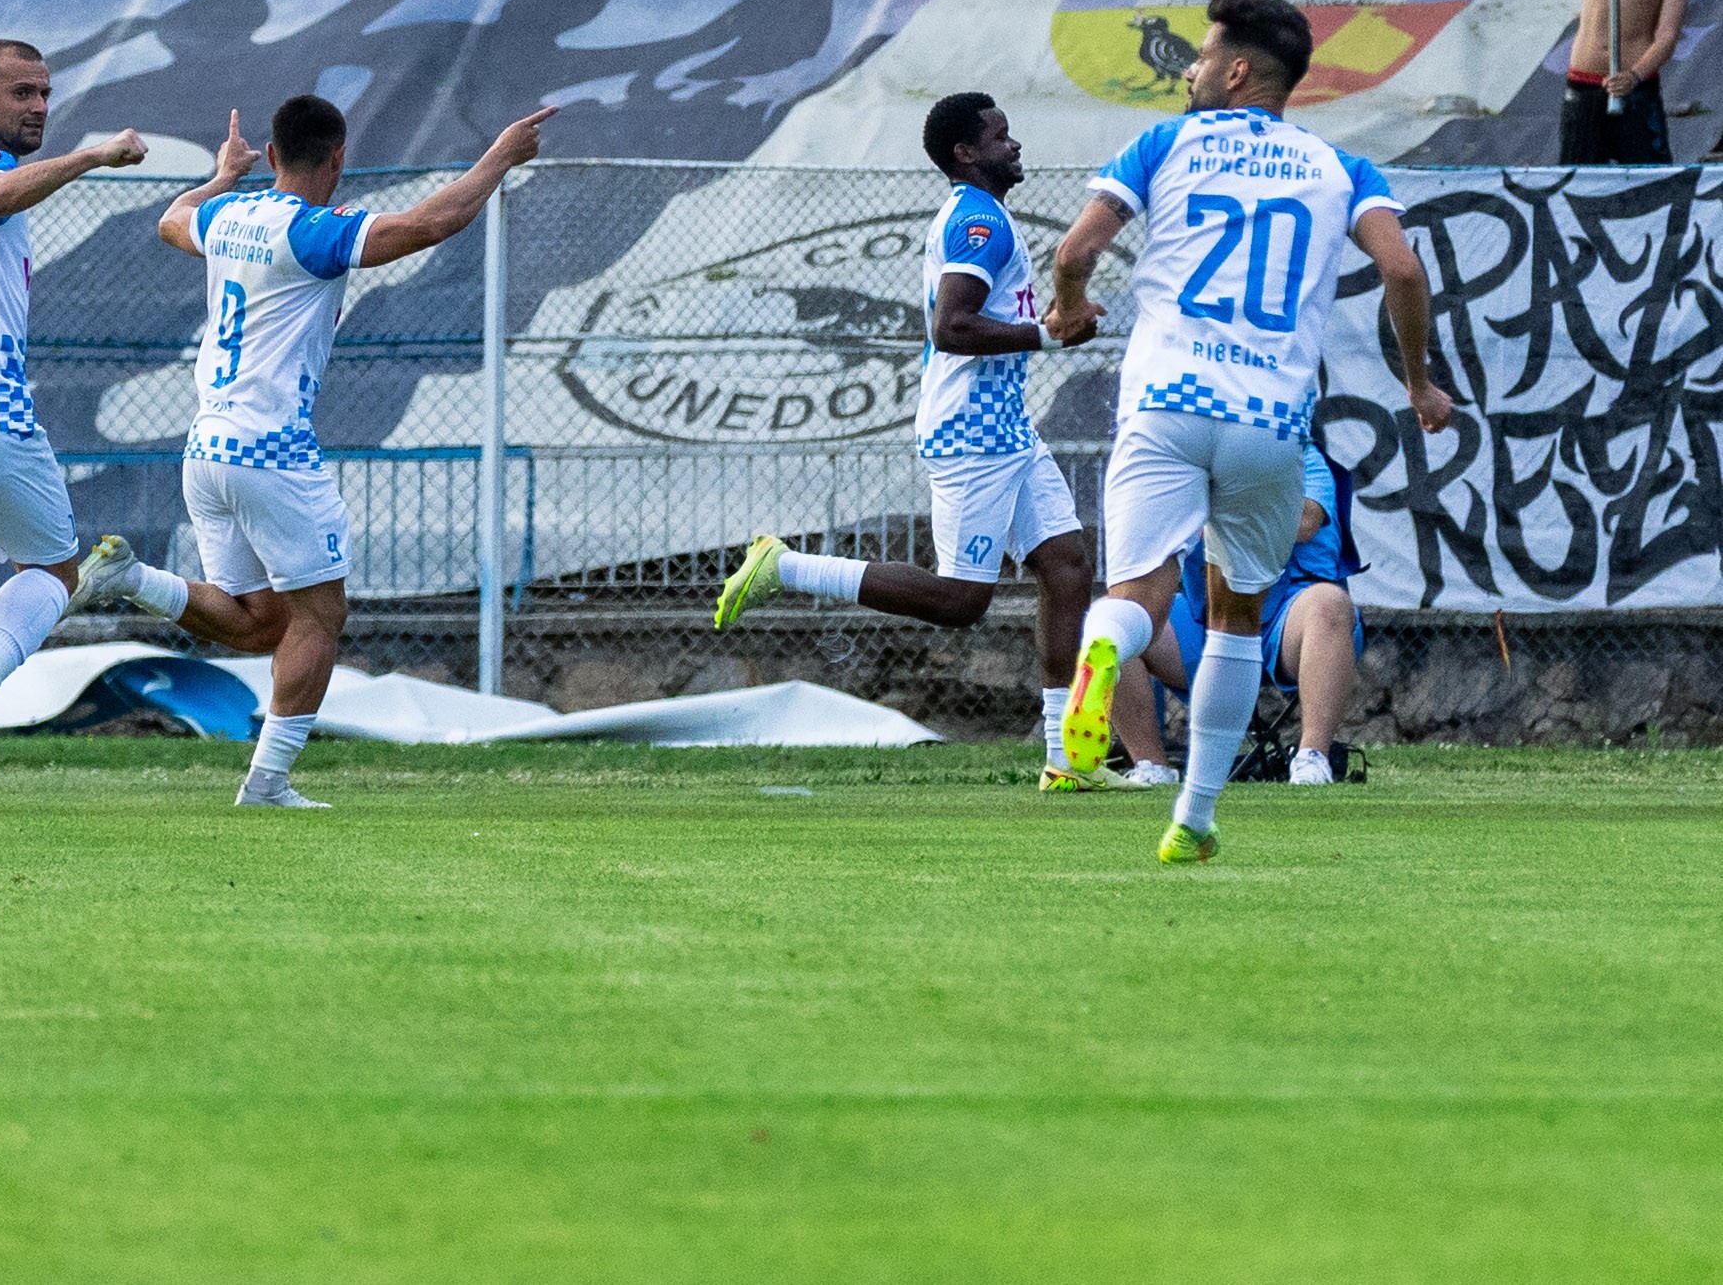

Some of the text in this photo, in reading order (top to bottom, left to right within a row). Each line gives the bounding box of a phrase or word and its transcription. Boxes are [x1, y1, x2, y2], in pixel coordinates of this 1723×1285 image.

[1202, 135, 1312, 164] CORVINUL
[1188, 155, 1323, 180] HUNEDOARA
[1178, 193, 1314, 333] 20
[210, 279, 247, 390] 9
[327, 533, 343, 564] 9
[963, 535, 993, 565] 47
